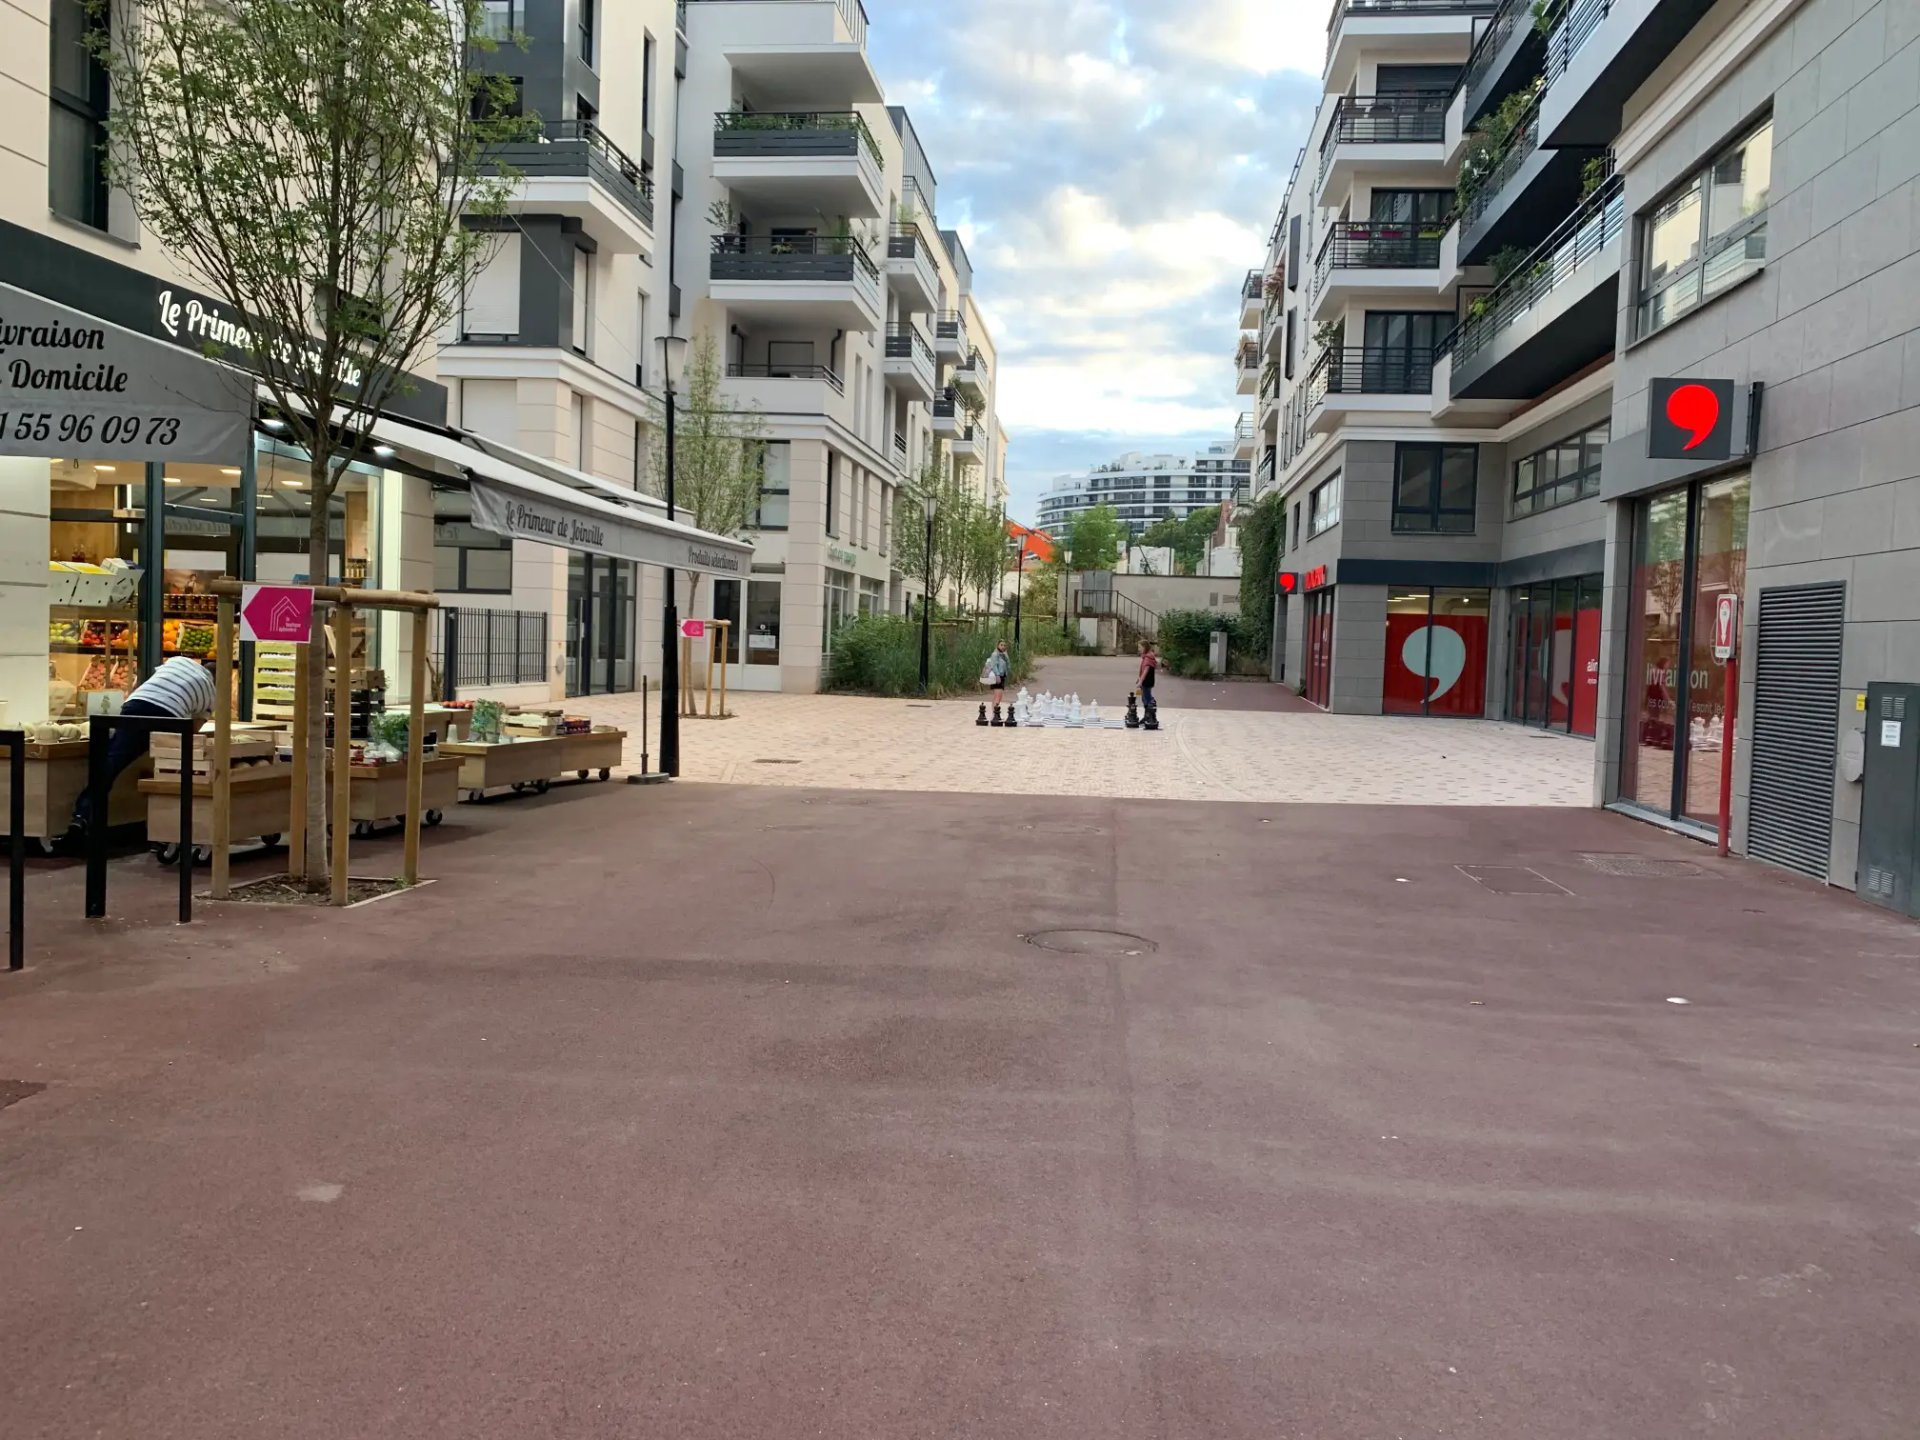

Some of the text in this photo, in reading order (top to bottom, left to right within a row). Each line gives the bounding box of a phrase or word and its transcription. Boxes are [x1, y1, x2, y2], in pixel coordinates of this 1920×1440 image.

[0, 317, 104, 351] ivraison
[159, 290, 181, 337] Le
[185, 299, 264, 353] Prime
[8, 359, 128, 392] Domicile
[14, 413, 52, 441] 55
[58, 414, 95, 443] 96
[100, 415, 141, 444] 09
[145, 417, 181, 445] 73
[505, 501, 604, 546] Le Primeur de Joinville
[1646, 662, 1708, 689] livraion
